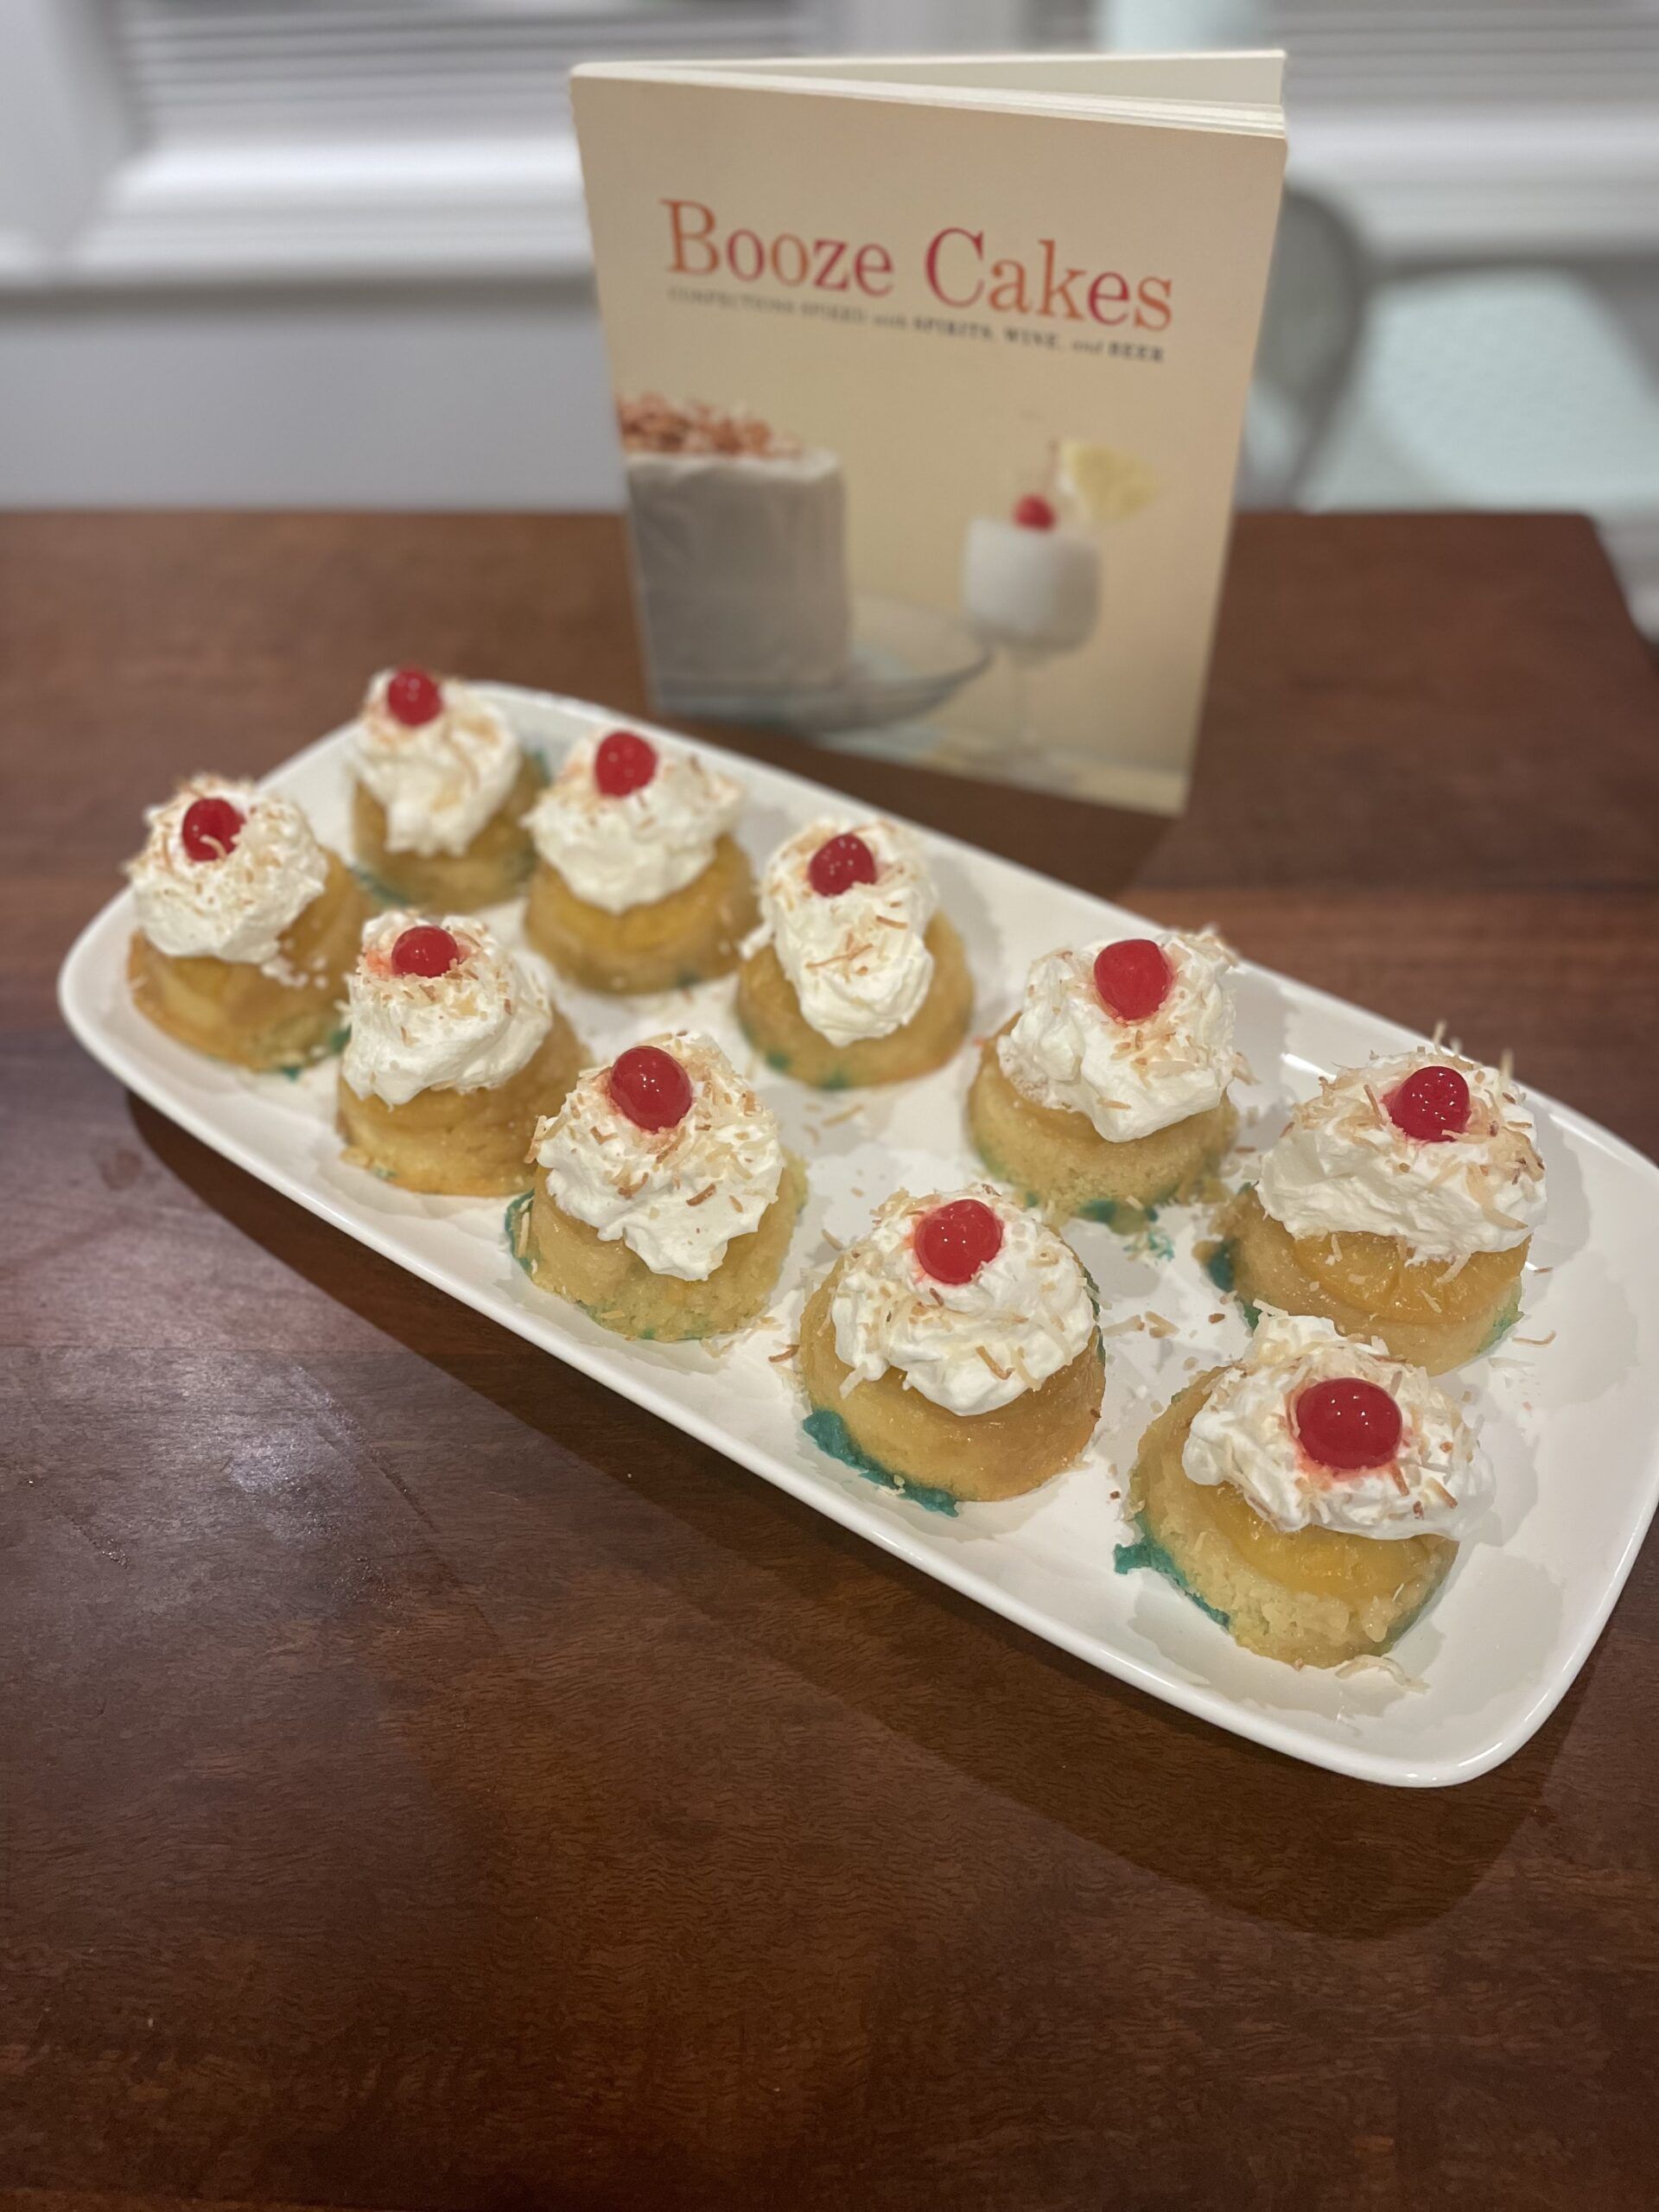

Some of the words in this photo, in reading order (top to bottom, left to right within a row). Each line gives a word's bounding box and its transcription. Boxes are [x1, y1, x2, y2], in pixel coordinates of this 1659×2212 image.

[660, 199, 894, 297] Booze
[925, 226, 1173, 332] Cakes
[1108, 340, 1164, 362] BEER
